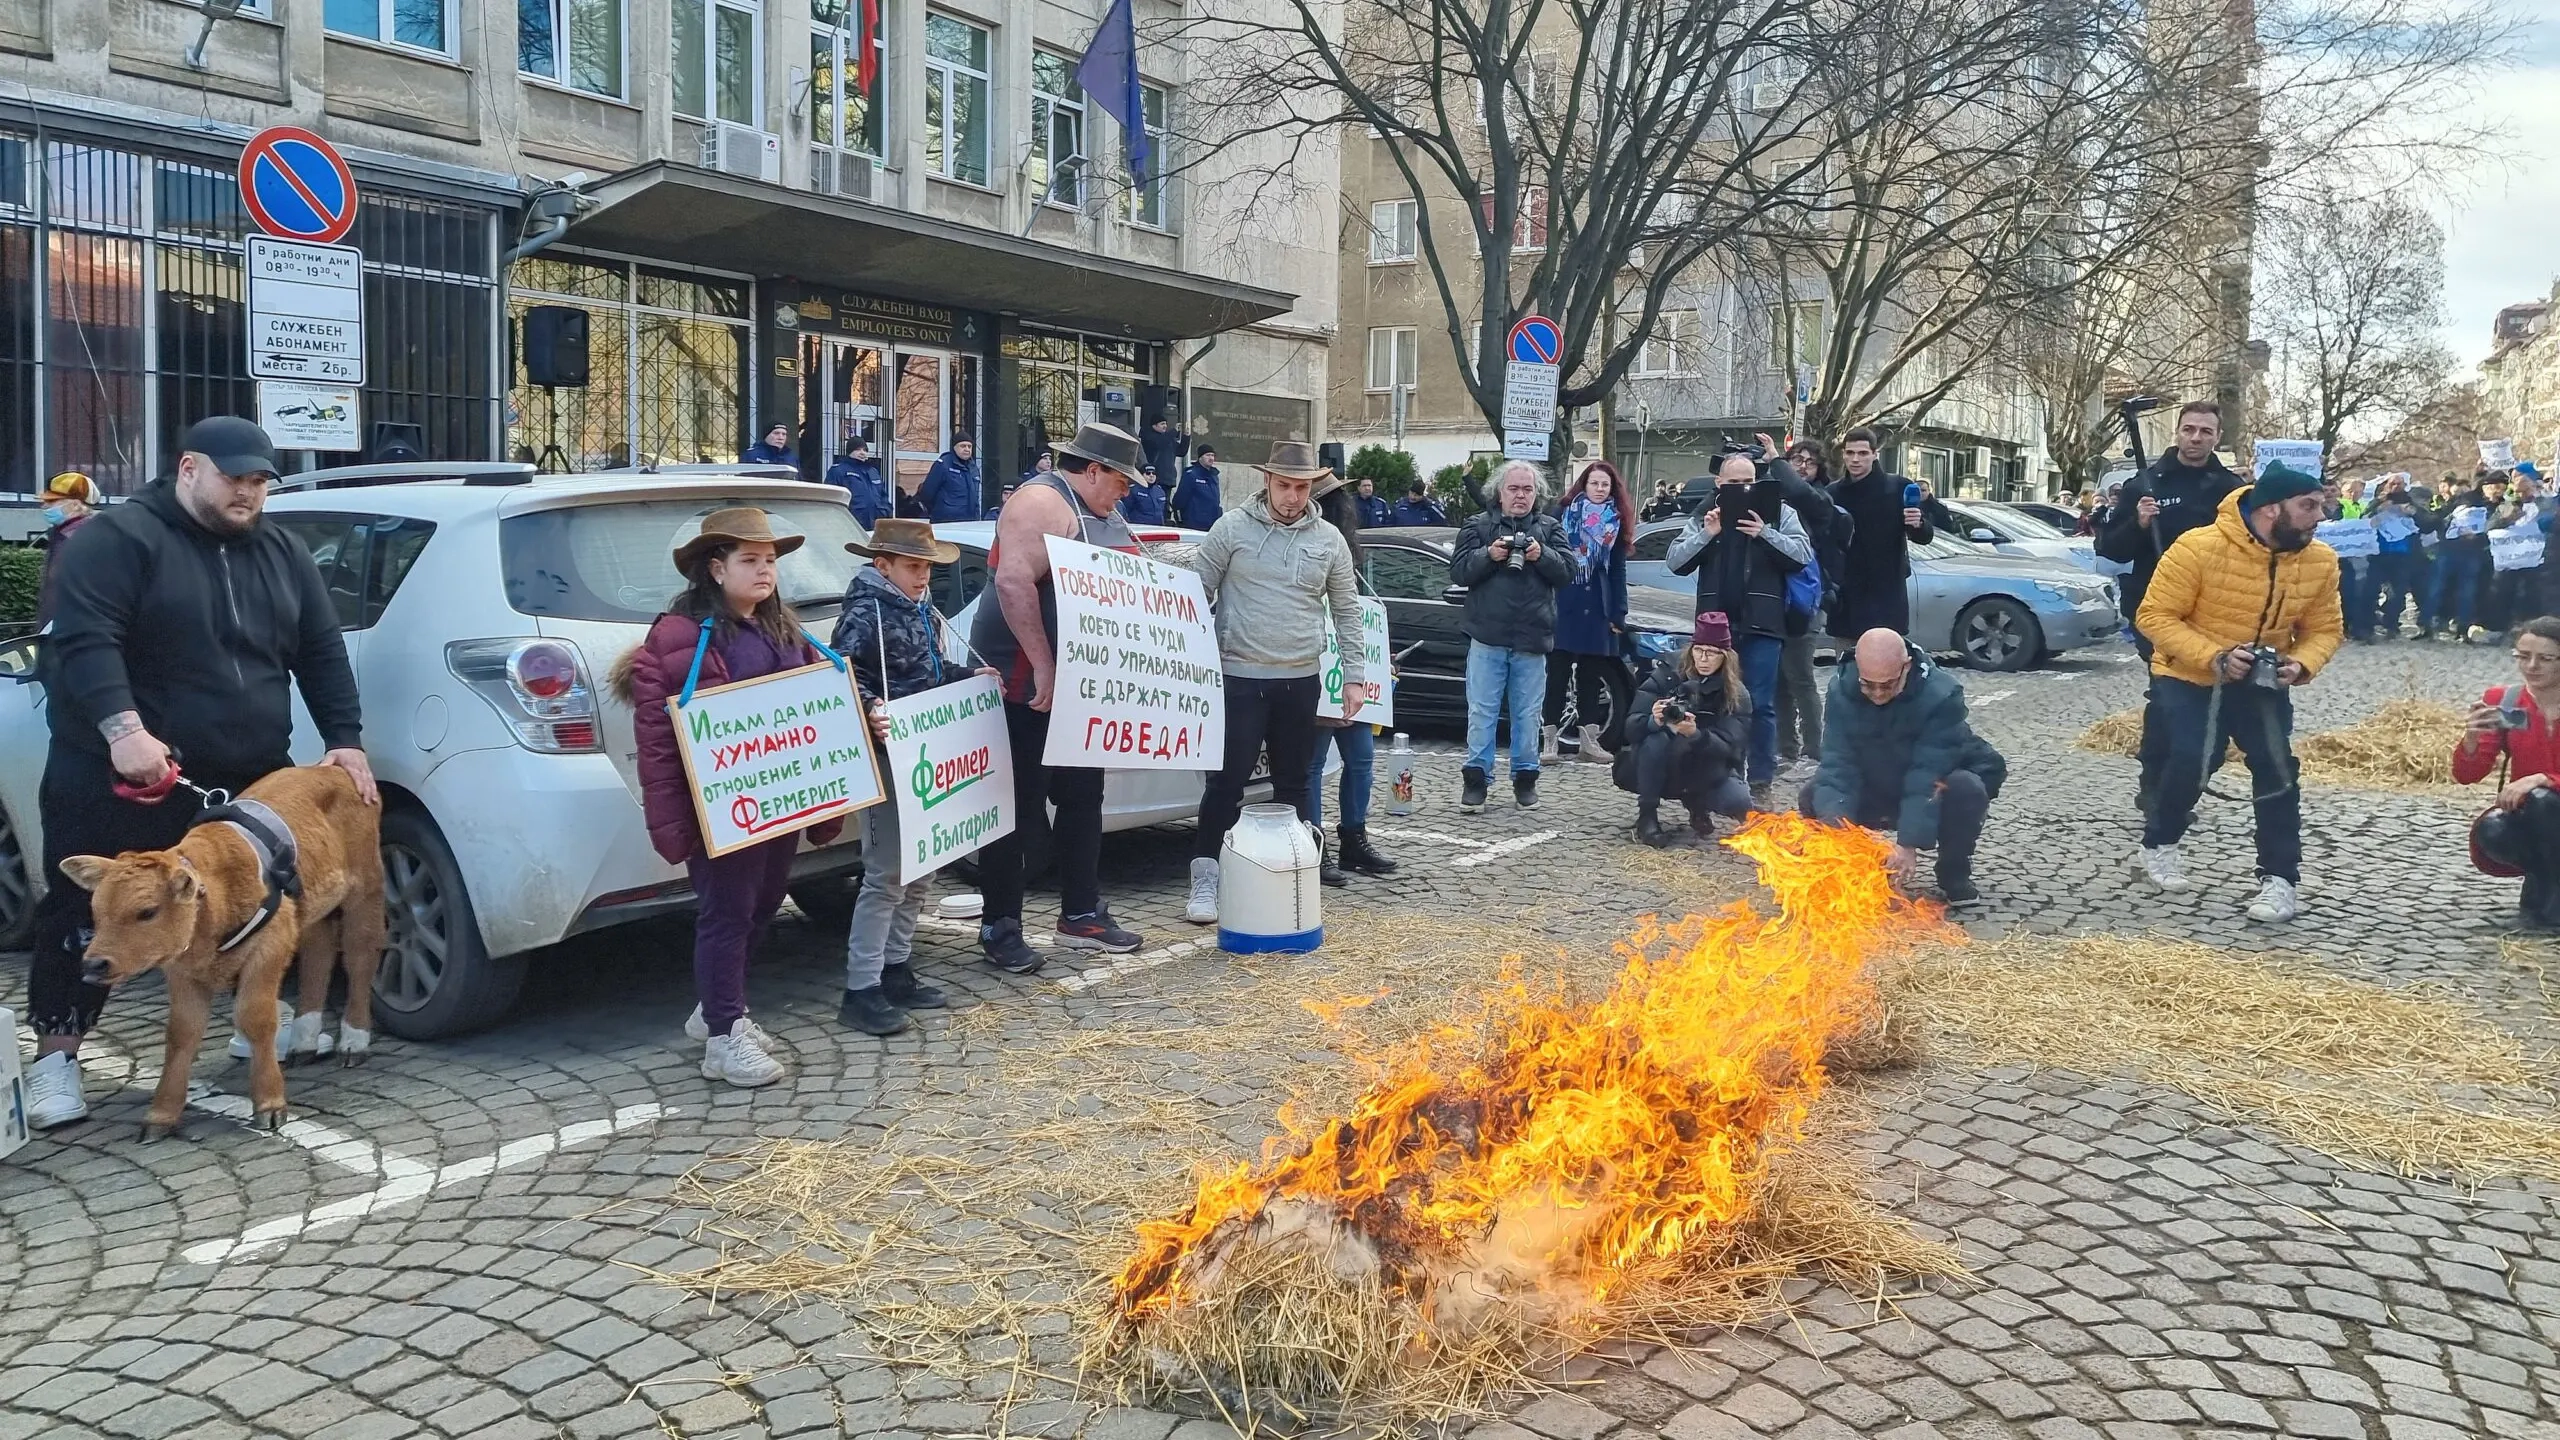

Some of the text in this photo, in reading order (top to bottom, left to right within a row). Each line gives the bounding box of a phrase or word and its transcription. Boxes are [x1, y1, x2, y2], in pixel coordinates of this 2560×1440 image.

[257, 245, 350, 266] В работни дни
[841, 293, 952, 326] СЛУЖЕБЕН ВХОД
[266, 336, 348, 353] АБОНАМЕНТ
[270, 319, 342, 337] СЛУЖЕБЕН
[840, 316, 953, 344] EMPLOYEES ONLY
[262, 360, 308, 372] места:
[1507, 406, 1551, 419] АБОНАМЕНТ
[1510, 396, 1549, 408] СЛУЖЕБЕН
[1100, 550, 1158, 585] ТОВА Е
[1058, 567, 1137, 608] ГОВЕДОТО
[1079, 612, 1186, 653] КОЕТО СЕ ЧУДИ
[1118, 647, 1222, 689] УПРАВЛЯВАЩИТЕ
[773, 705, 799, 728] ДА
[803, 694, 846, 717] ИМА
[910, 703, 957, 734] искам
[959, 696, 975, 721] да
[976, 688, 1002, 713] съм
[1080, 677, 1210, 718] СЕ ДЪРЖАТ КАТО
[709, 724, 818, 773] ХУМАННО
[702, 745, 862, 804] ОТНОШЕНИЕ И КЪМ
[911, 742, 990, 812] Фермер
[917, 805, 999, 865] в България
